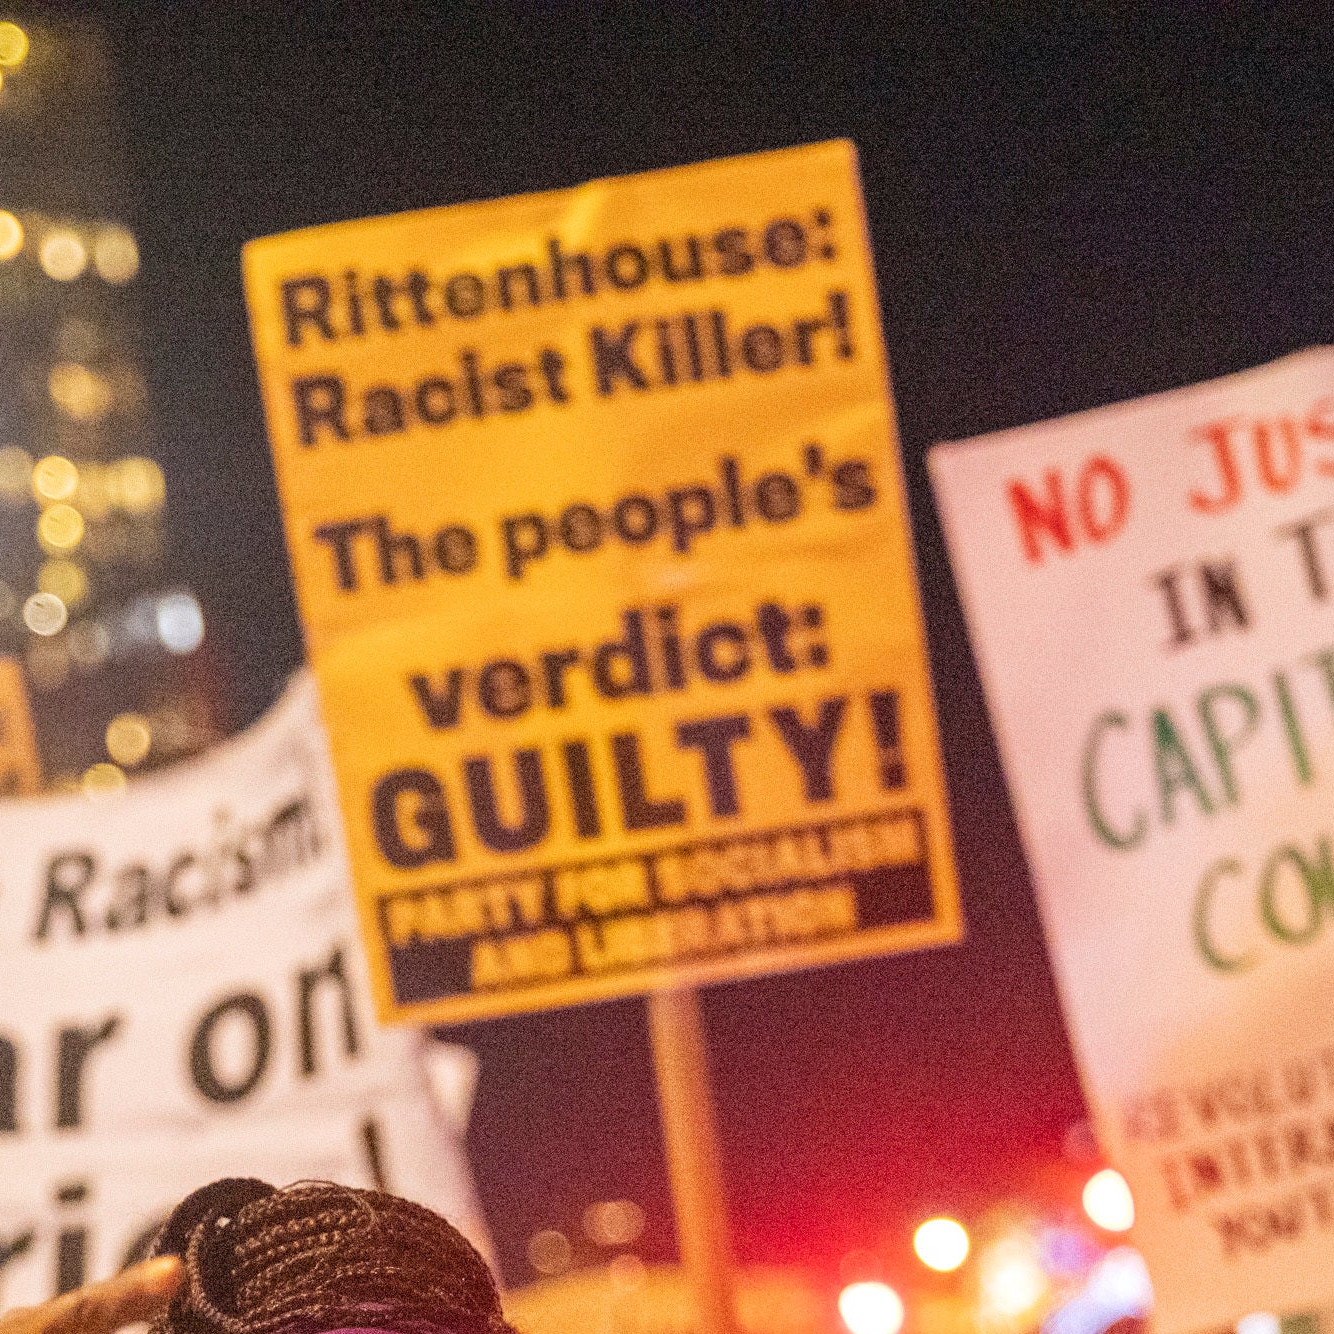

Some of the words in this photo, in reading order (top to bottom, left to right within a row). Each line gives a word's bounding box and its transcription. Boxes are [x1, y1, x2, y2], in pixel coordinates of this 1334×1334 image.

[281, 207, 838, 347] Rittenhouse:
[292, 348, 568, 447] Racist
[589, 290, 855, 397] Killer!
[314, 516, 478, 593] The
[501, 444, 877, 580] people's
[1005, 453, 1132, 563] NO
[407, 603, 829, 731] verdict:
[1149, 556, 1251, 648] IN
[370, 690, 909, 870] GUILTY!
[385, 880, 543, 947] PARTY
[556, 861, 646, 918] FOR
[658, 818, 920, 900] SOCIALISM
[468, 929, 571, 991] AND
[576, 887, 857, 974] LIBERATION
[189, 943, 363, 1106] on
